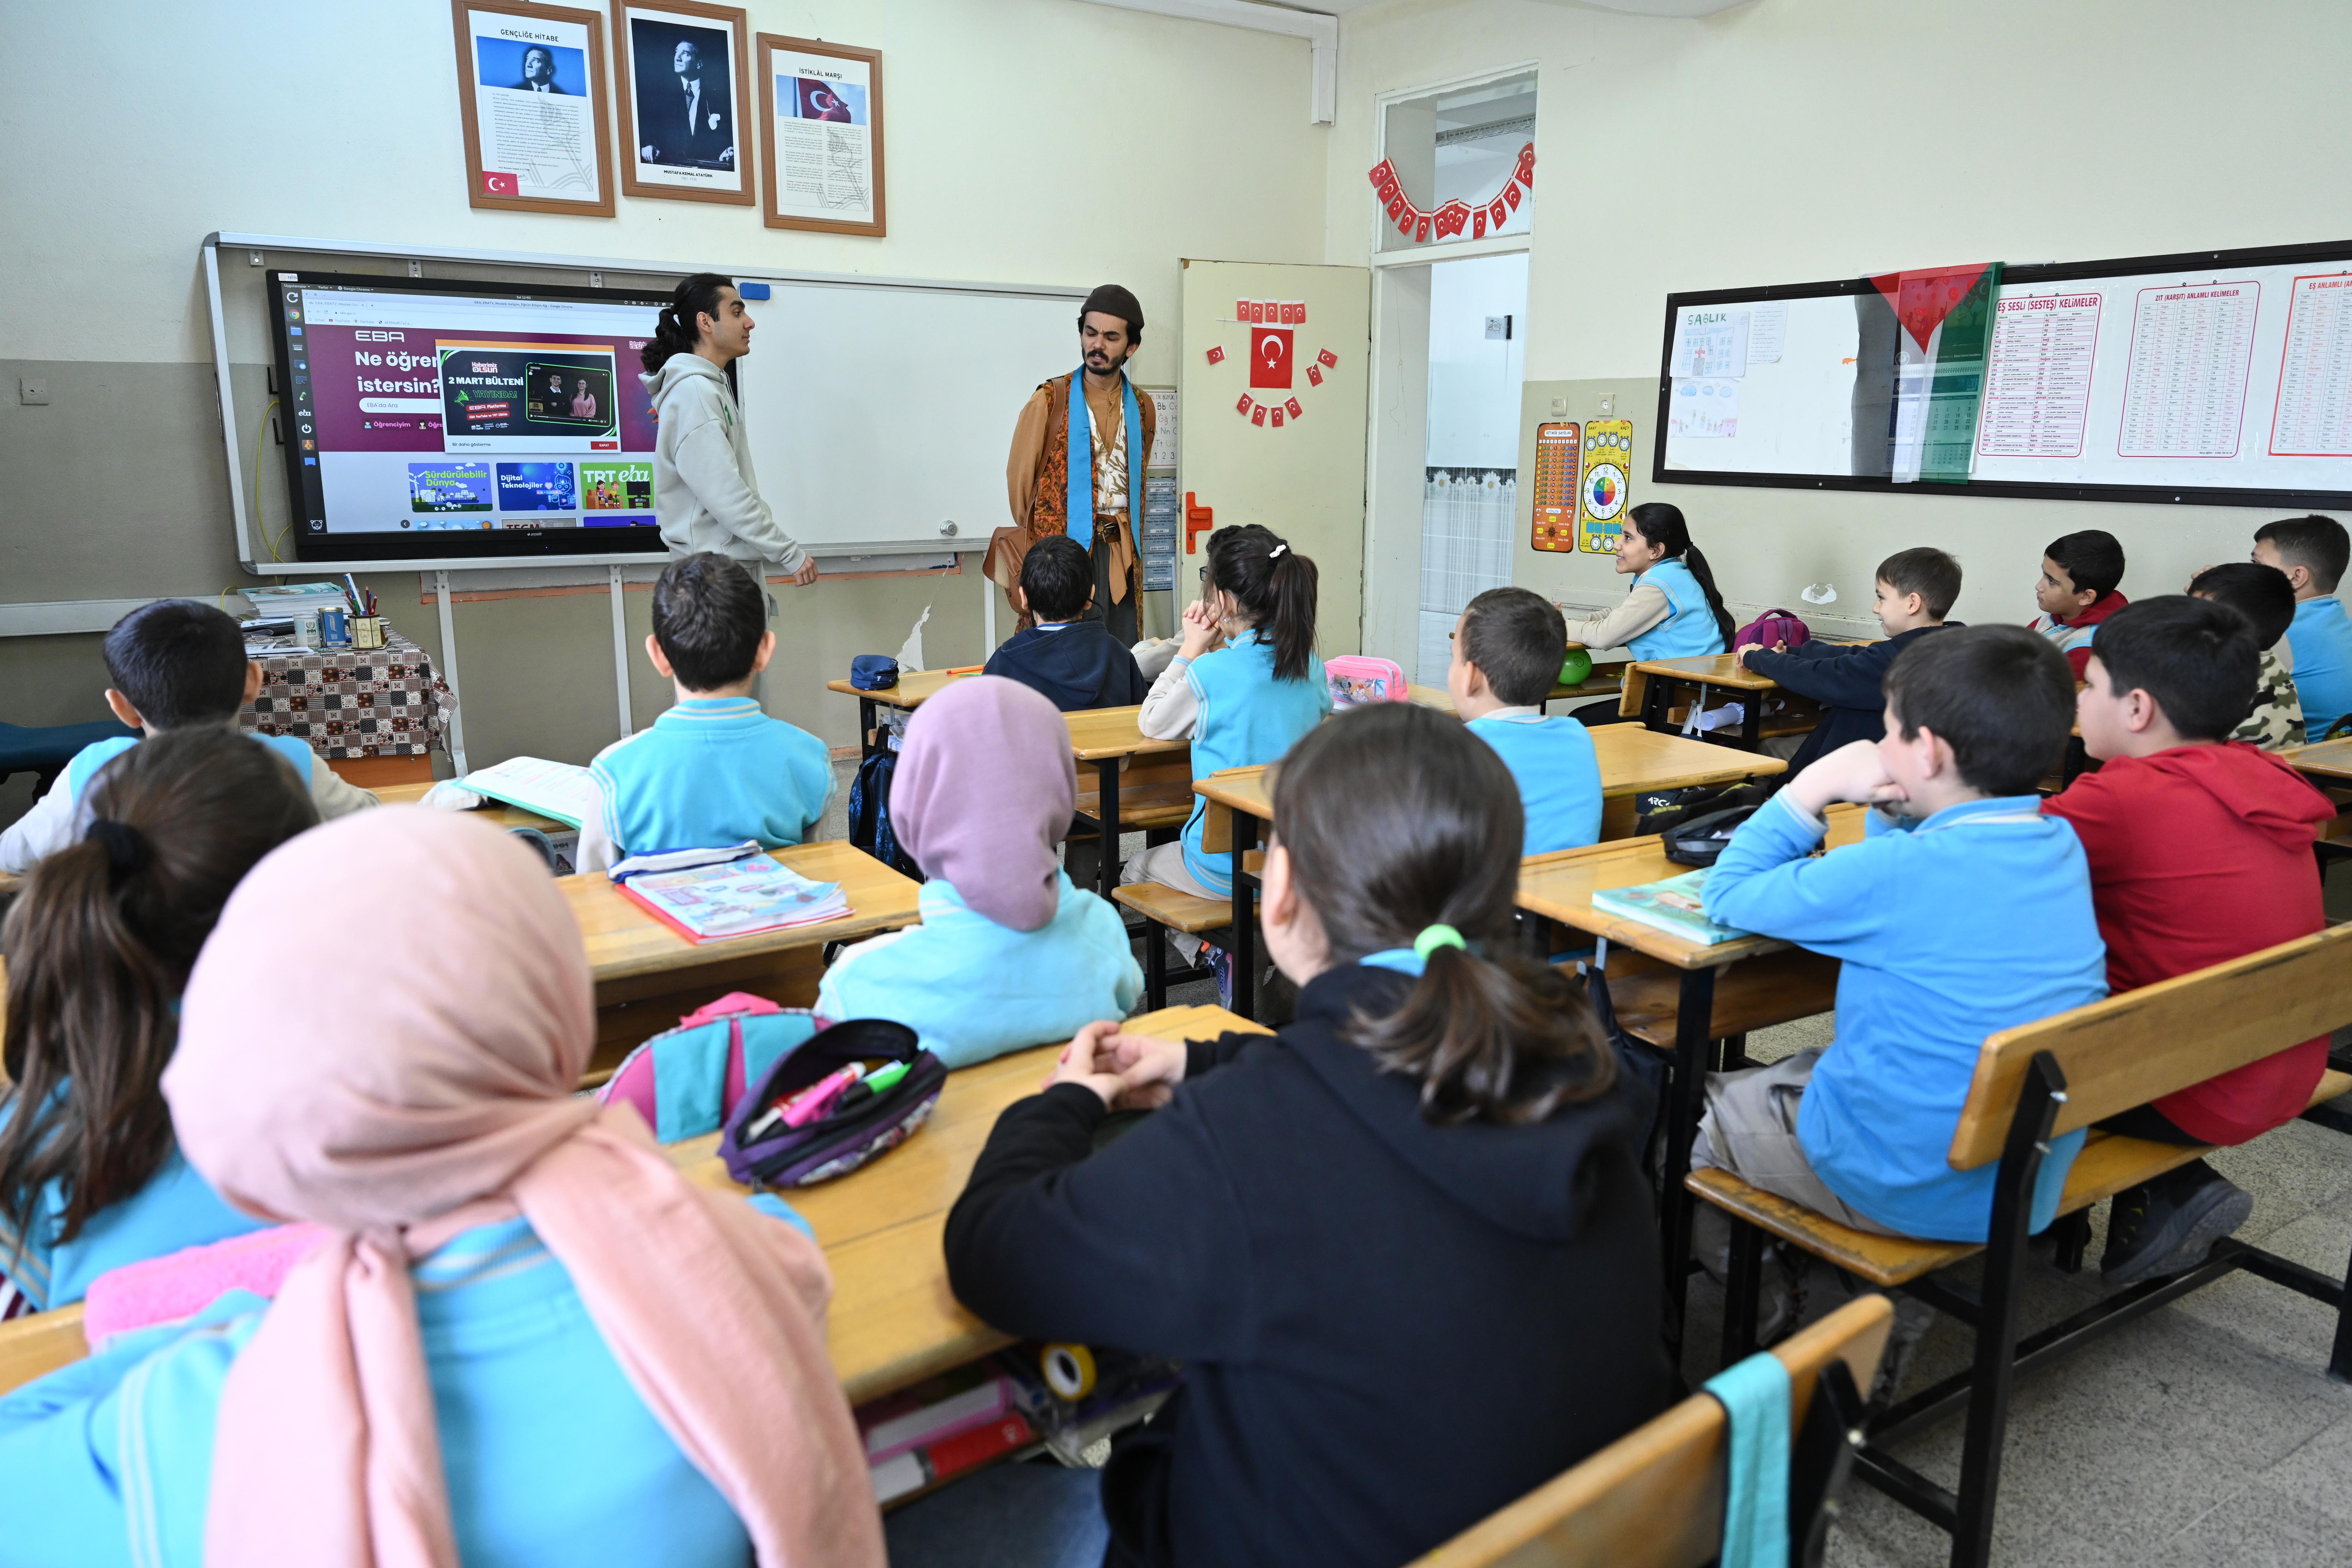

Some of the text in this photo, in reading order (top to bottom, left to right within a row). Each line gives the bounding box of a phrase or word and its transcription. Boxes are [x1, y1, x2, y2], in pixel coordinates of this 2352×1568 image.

[501, 29, 559, 42] GENÇLİĞE HİTABE
[799, 67, 824, 76] İSTİKLÂL
[2164, 293, 2185, 302] (KARŞIT)
[1998, 297, 2098, 313] EŞ SESLİ (SESTEŞ) KELİMELER
[1688, 313, 1726, 325] SAĞLIK
[355, 330, 405, 342] EBA
[355, 351, 382, 366] Ne
[357, 376, 440, 393] istersin?
[485, 376, 524, 386] BÜLTENİ
[1158, 413, 1168, 425] Ğğ
[425, 471, 487, 479] Sürdürülebilir
[583, 465, 650, 482] TRT eba
[426, 479, 455, 488] Dünya
